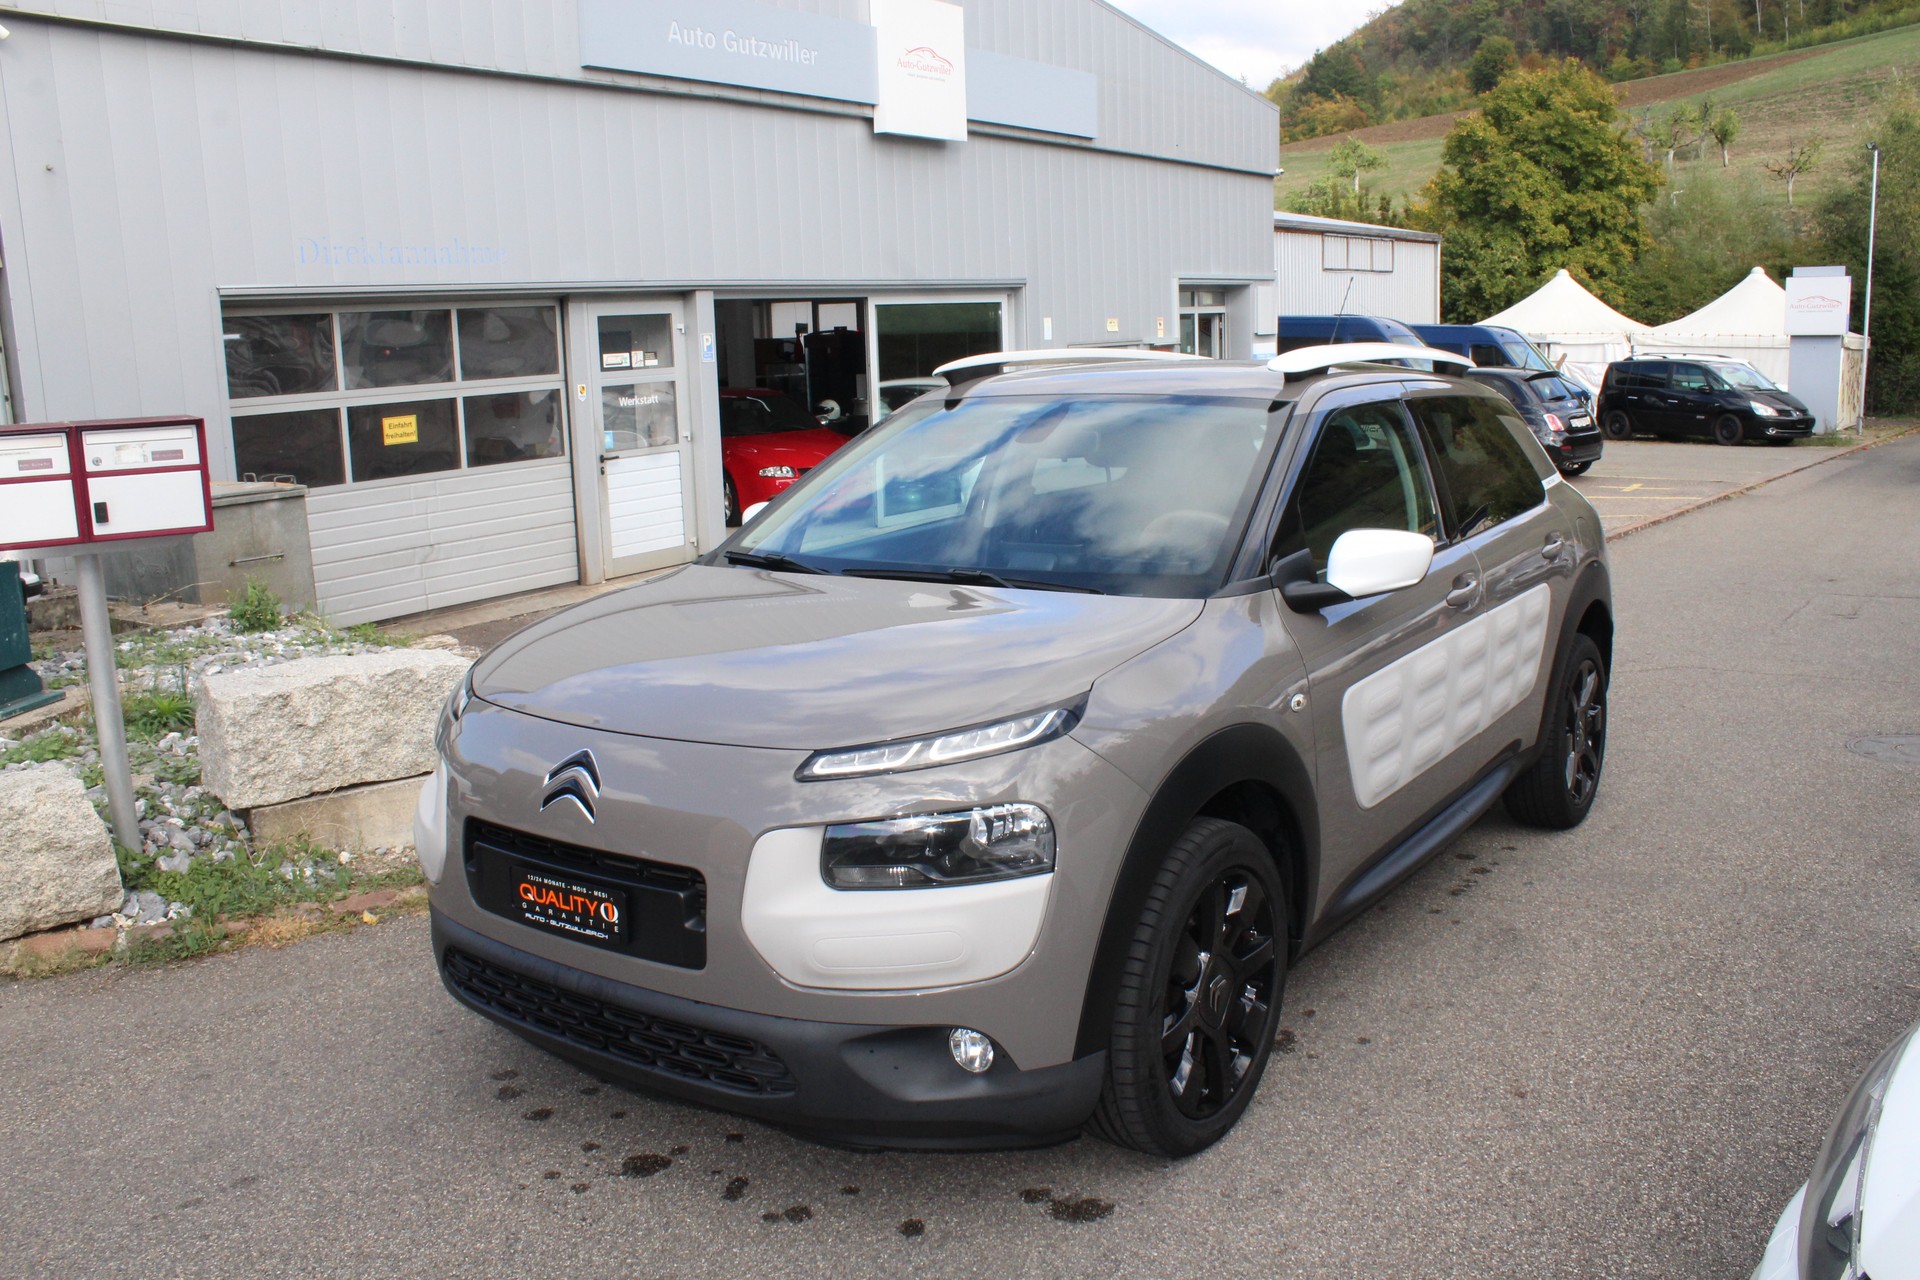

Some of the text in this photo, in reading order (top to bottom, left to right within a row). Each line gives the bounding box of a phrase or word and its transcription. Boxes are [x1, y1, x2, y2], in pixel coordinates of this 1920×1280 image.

[668, 20, 818, 65] Auto Gutzwiller
[299, 237, 509, 265] Direktannahme
[618, 395, 659, 407] Werkstatt
[385, 430, 416, 439] freihalten!
[388, 422, 412, 430] Einfahrt
[527, 874, 542, 883] 12/24
[543, 878, 566, 889] MONATE
[572, 885, 587, 894] MOIS
[593, 890, 608, 899] MESI
[519, 883, 598, 917] QUALITY
